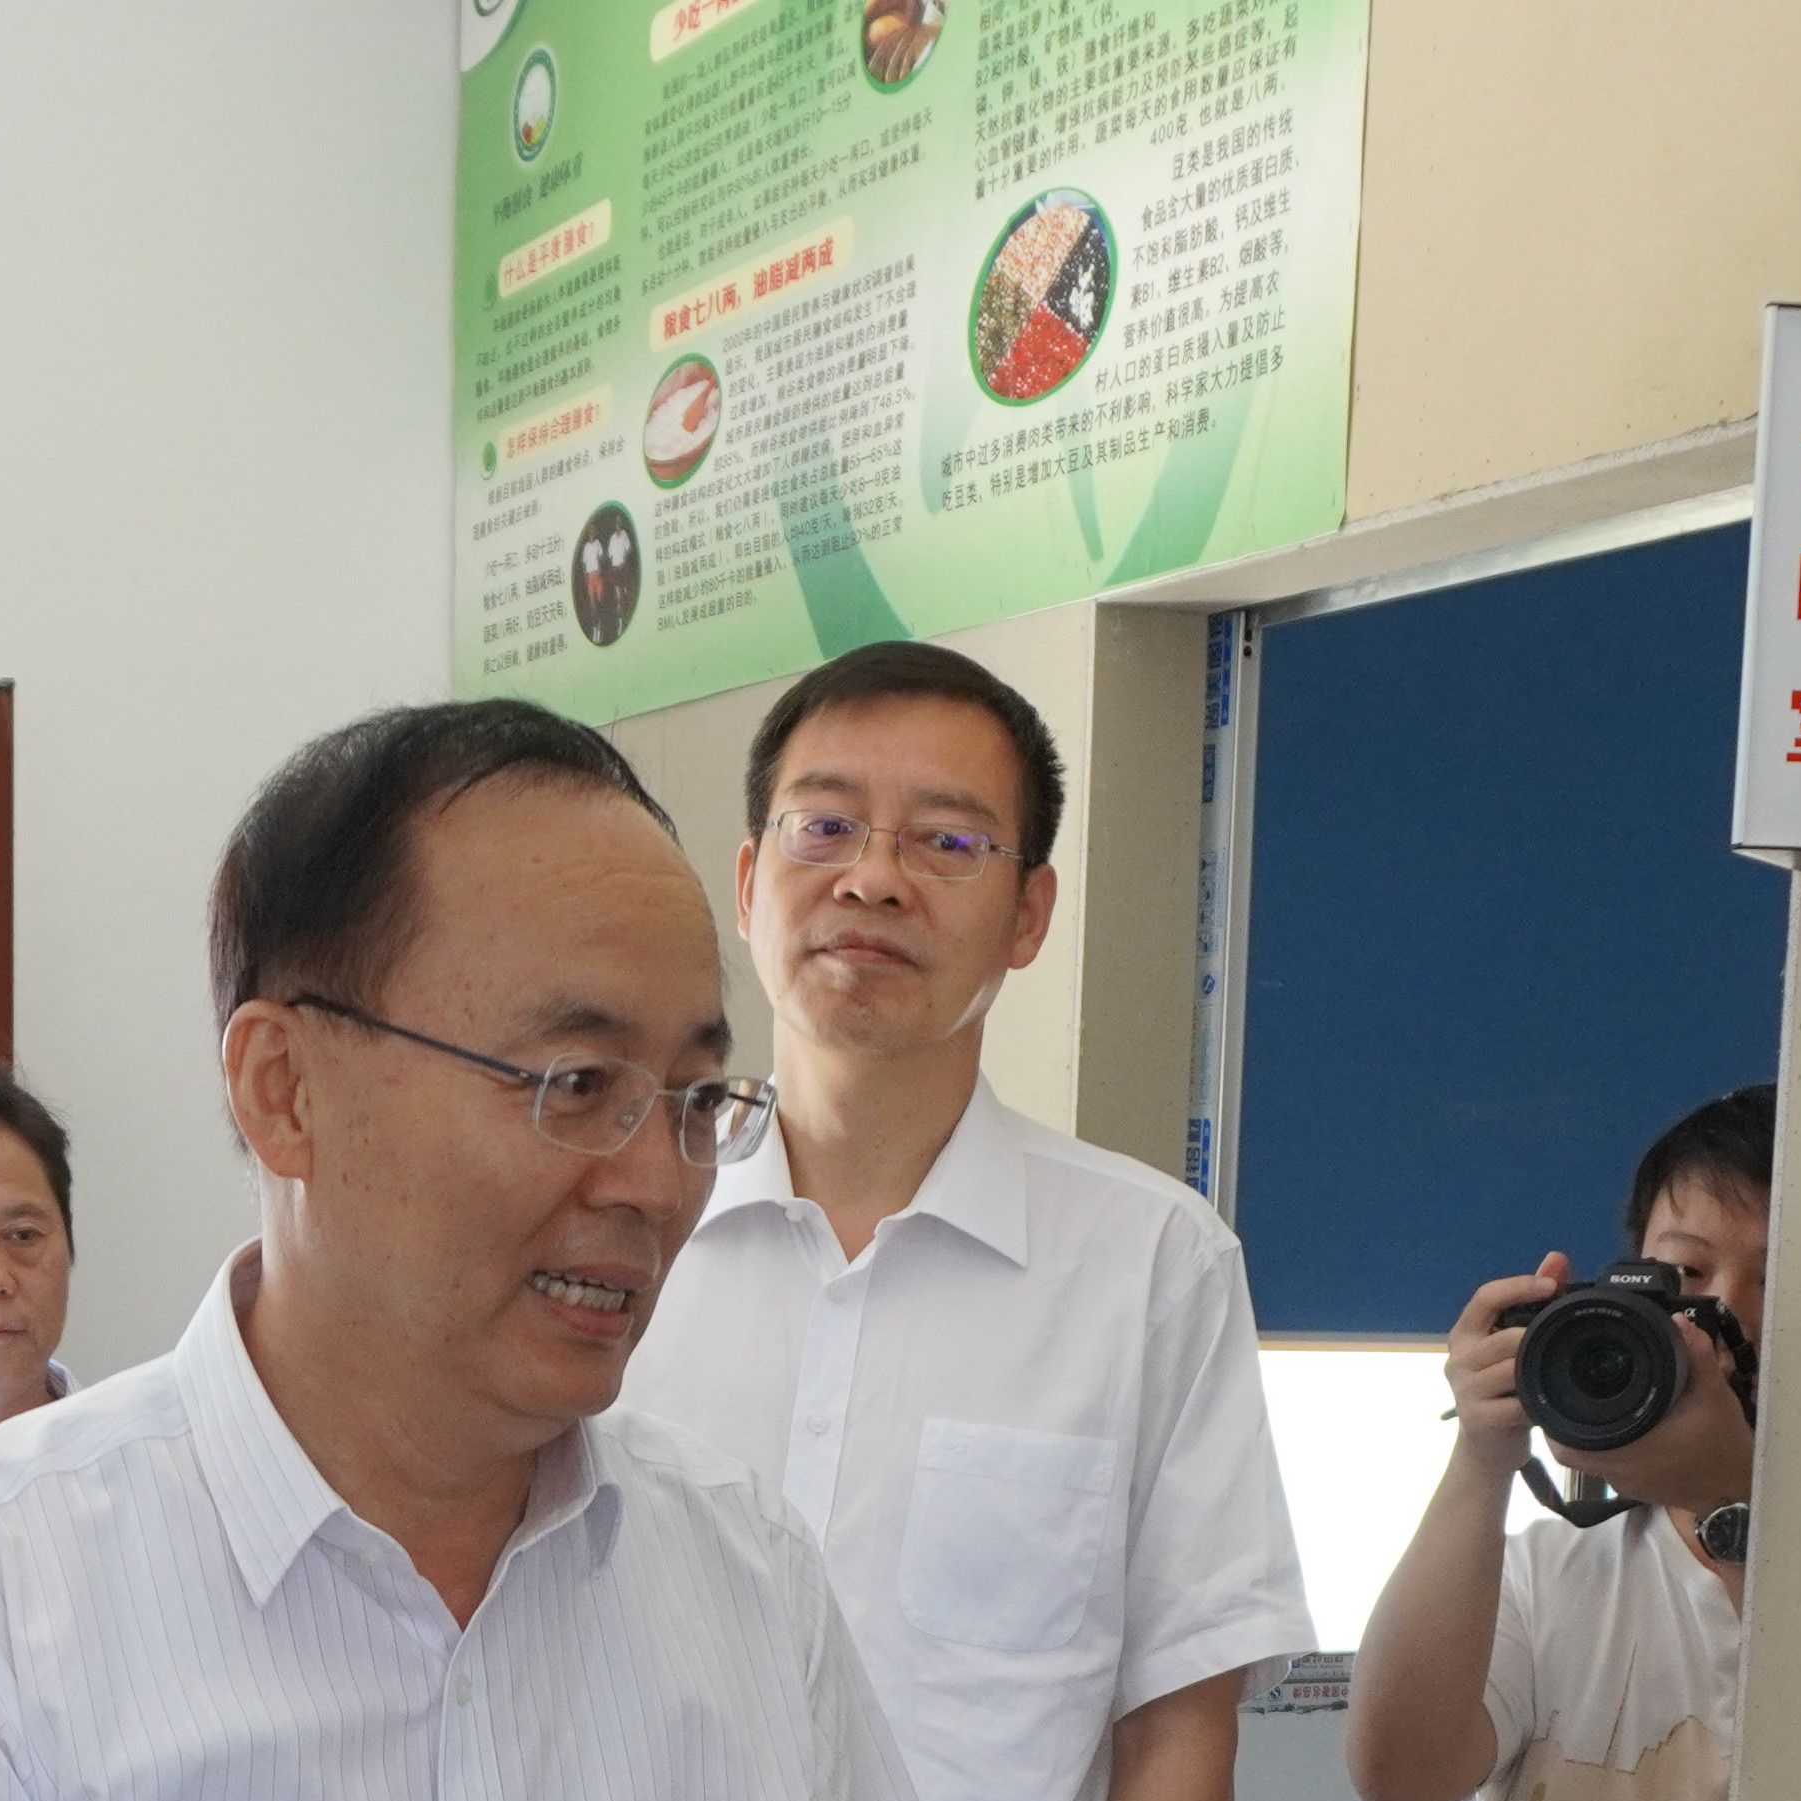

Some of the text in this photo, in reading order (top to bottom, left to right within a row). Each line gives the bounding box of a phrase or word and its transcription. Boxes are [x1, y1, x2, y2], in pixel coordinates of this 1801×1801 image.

[1172, 107, 1293, 182] 豆类是我国的传统
[664, 236, 834, 342] 粮食七八两，油脂减两成
[1095, 304, 1286, 394] 村人口的蛋白质摄入量及防止
[1609, 1274, 1653, 1284] SONY
